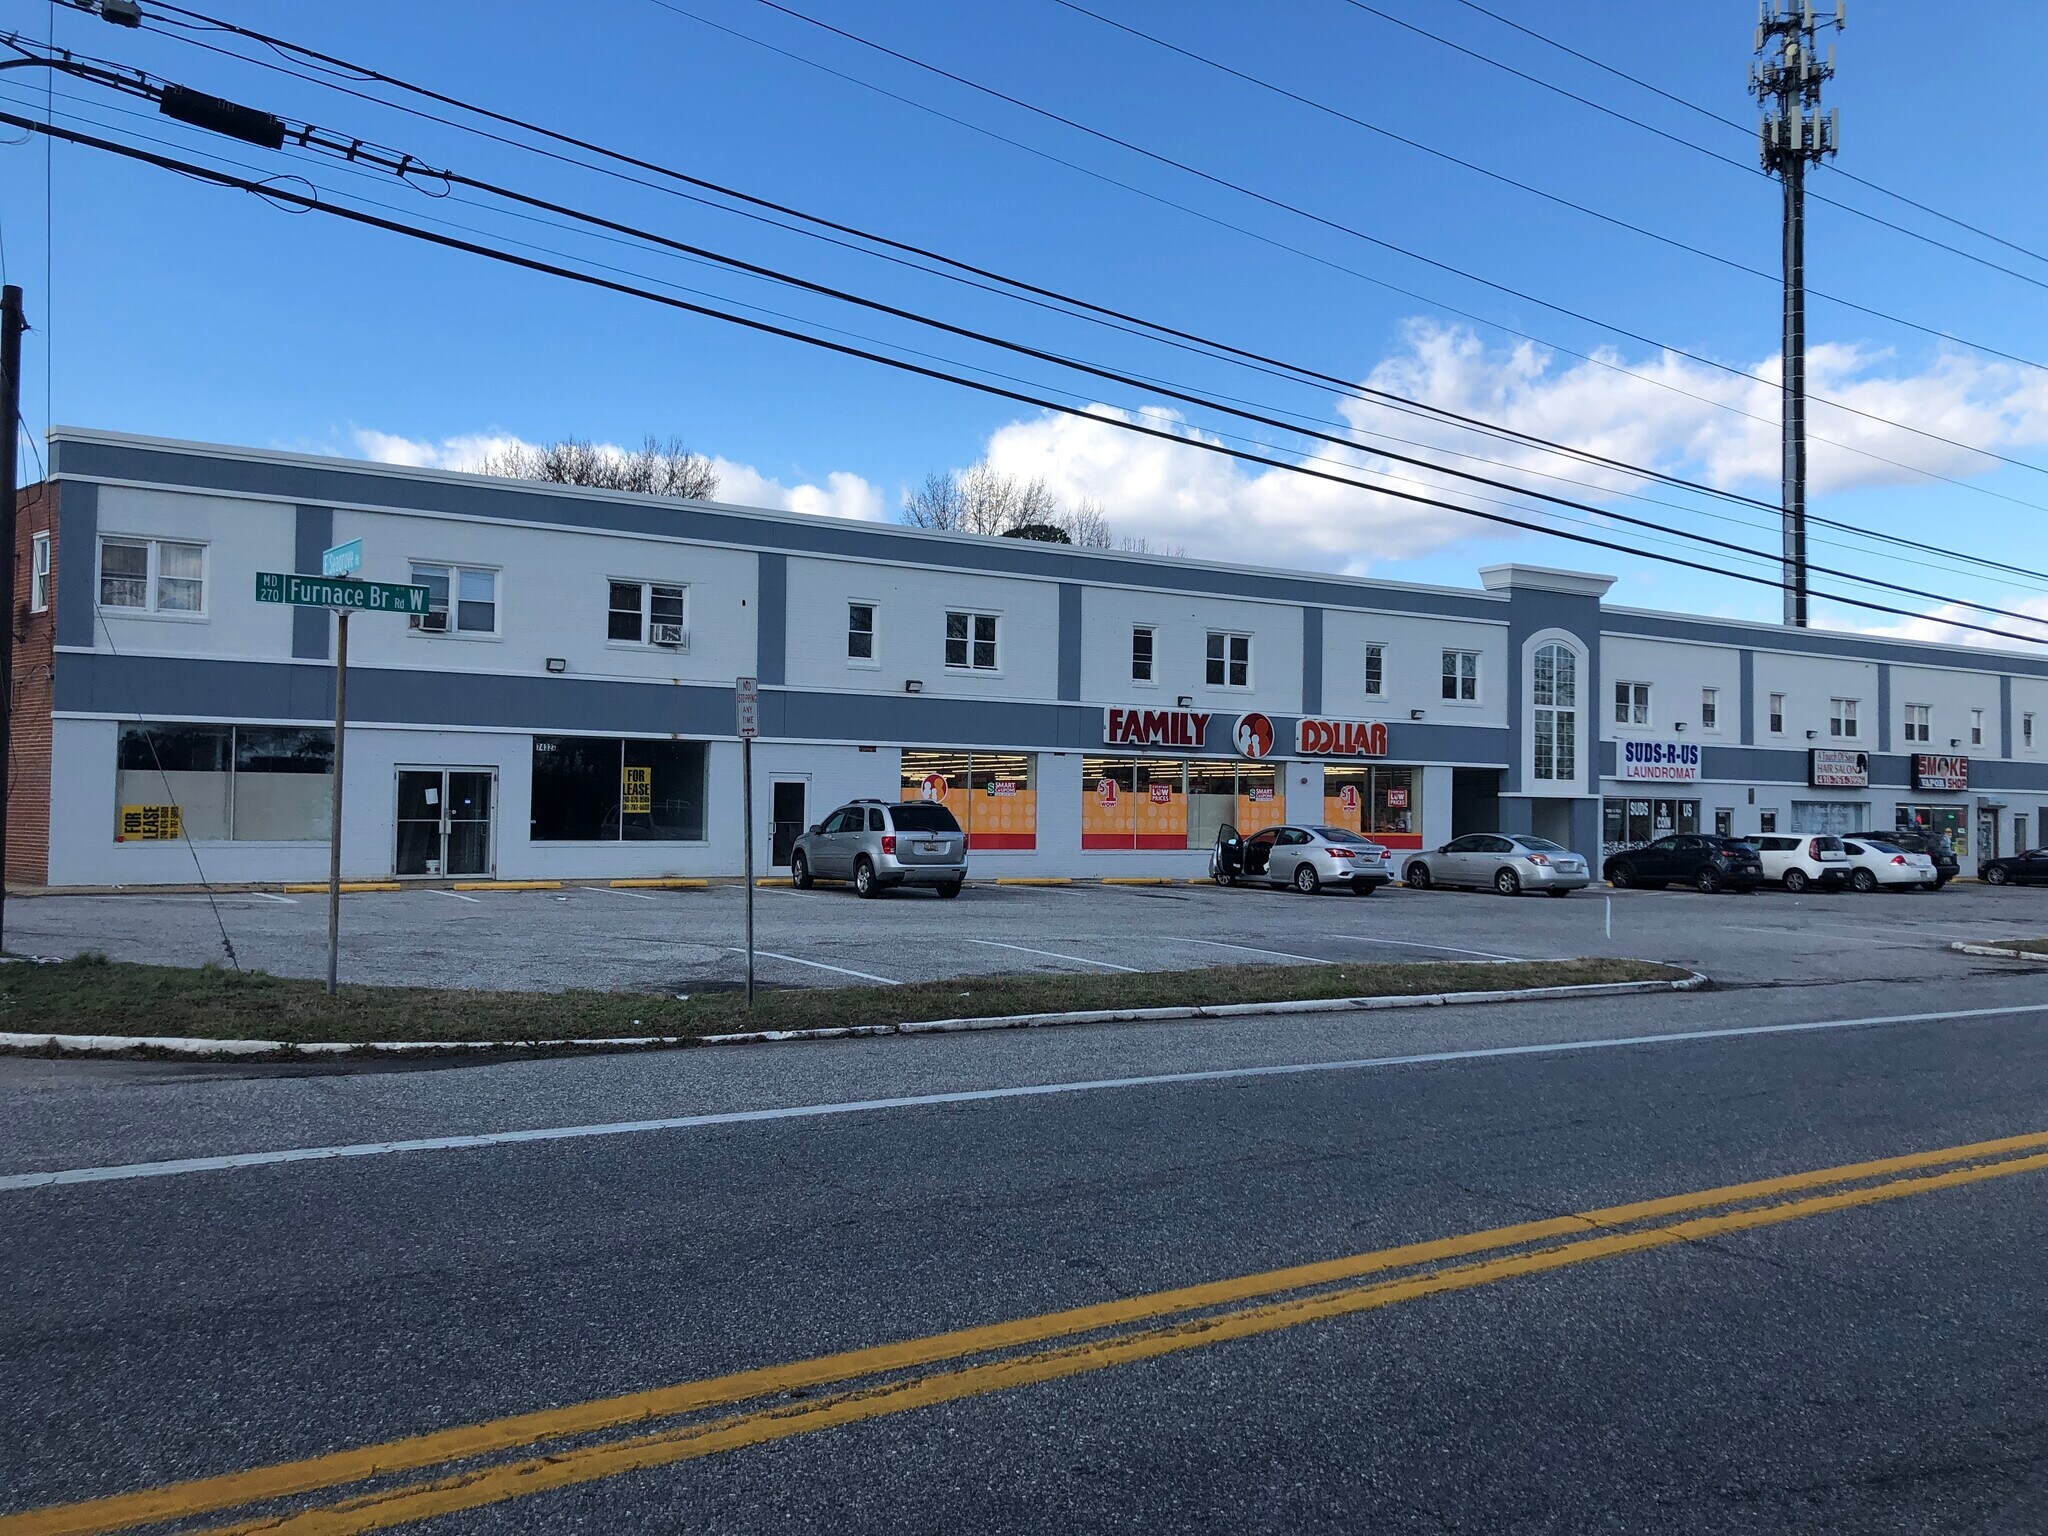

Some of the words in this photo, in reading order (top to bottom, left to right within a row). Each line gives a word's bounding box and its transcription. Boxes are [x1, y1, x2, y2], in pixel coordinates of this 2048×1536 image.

[263, 574, 278, 587] MD
[260, 588, 279, 602] 270
[290, 579, 364, 606] Furnace
[370, 585, 389, 608] Br
[394, 597, 405, 609] Rd
[409, 589, 424, 611] W
[742, 681, 751, 691] NO
[738, 693, 757, 703] STOPPING
[742, 716, 754, 724] TIME
[1108, 708, 1211, 745] FAMILY
[1301, 719, 1387, 755] DOLLAR
[1625, 741, 1698, 765] SUDS-R-US
[628, 769, 645, 782] FOR
[1626, 766, 1696, 780] LAUNDROMAT
[1817, 763, 1833, 773] HAIR
[1834, 764, 1857, 774] SALON
[623, 783, 649, 795] LEASE
[1100, 780, 1117, 801] $1
[1920, 779, 1945, 787] VAPOR
[1947, 778, 1967, 789] SHOP
[1341, 787, 1357, 806] $1
[1630, 801, 1649, 816] SUDS
[1683, 803, 1693, 817] US
[125, 813, 141, 833] FOR
[142, 806, 159, 839] LEASE
